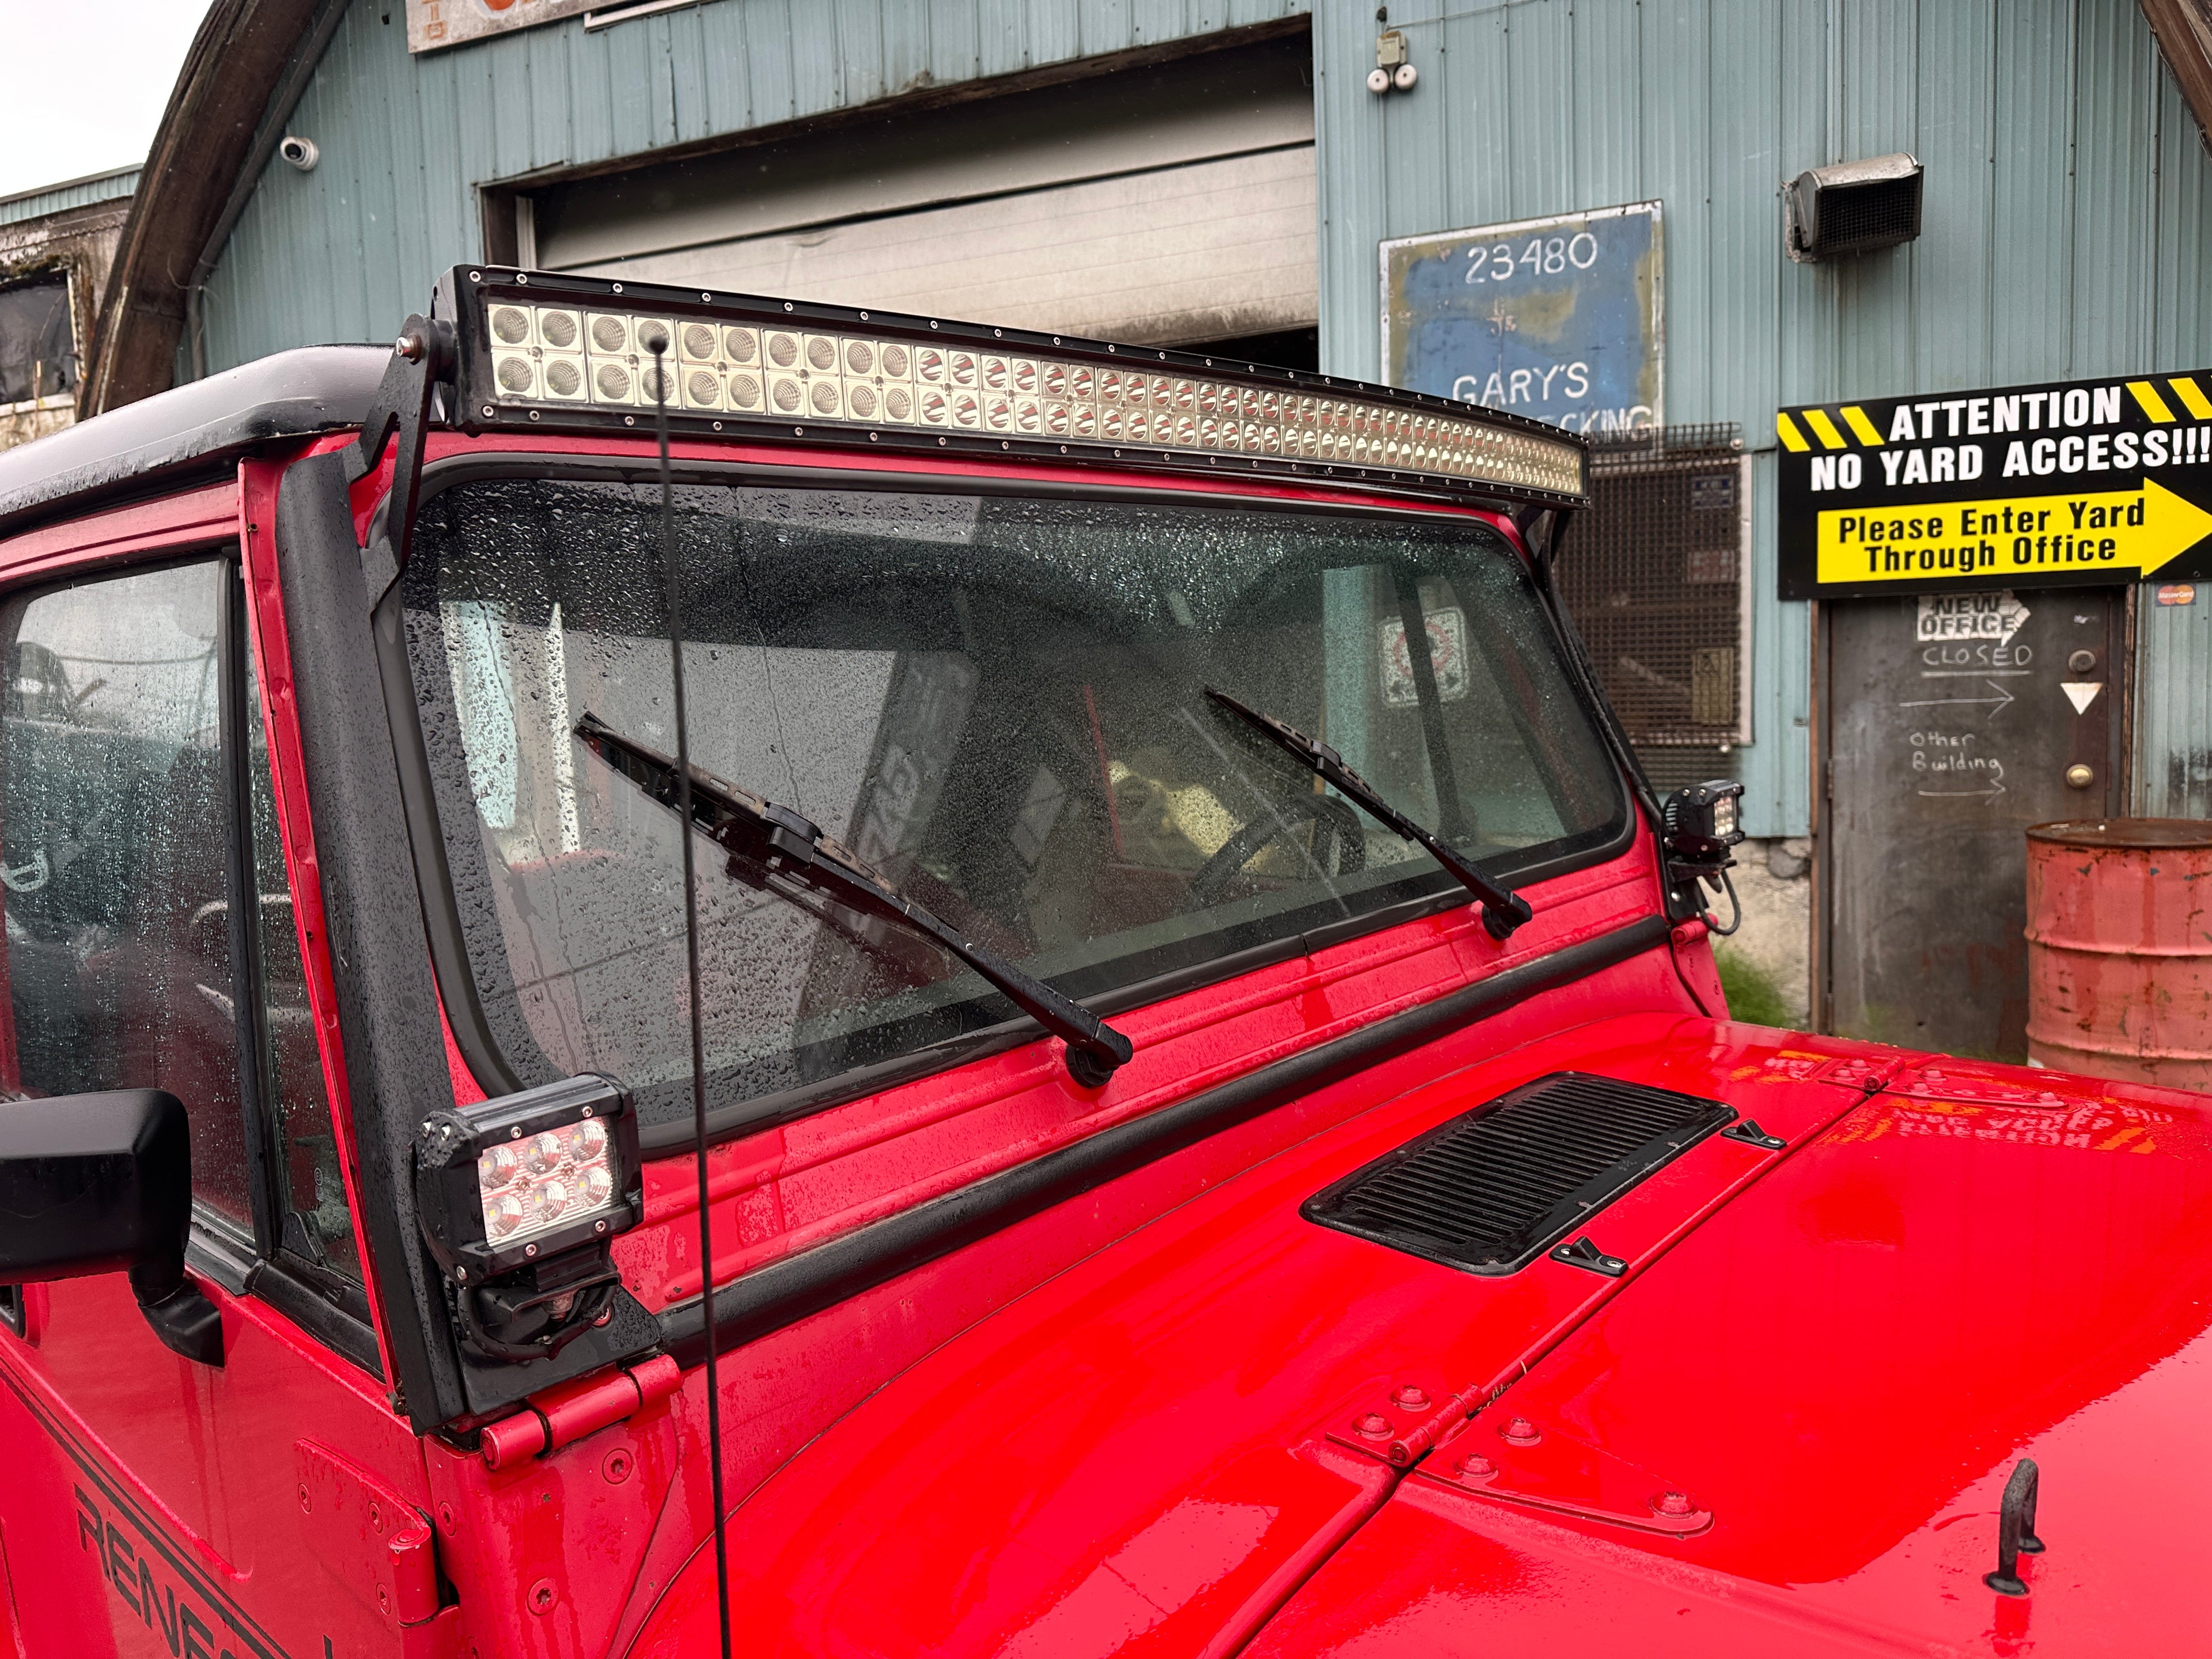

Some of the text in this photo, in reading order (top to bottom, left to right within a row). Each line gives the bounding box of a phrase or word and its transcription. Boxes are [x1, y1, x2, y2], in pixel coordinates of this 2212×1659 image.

[1465, 232, 1598, 284] 23480
[1452, 361, 1589, 407] GARY'S
[1889, 386, 2122, 442] ATTENTION
[1810, 426, 2211, 491] NO YARD ACCESS!!!
[1839, 497, 2145, 543] Please Enter Yard
[1864, 536, 2116, 573] Through Office
[1921, 614, 2017, 634] OFFICE
[1932, 596, 2001, 615] NEW
[1922, 644, 2033, 666] CLOSED
[1912, 750, 2004, 782] Building
[73, 1482, 237, 1659] RENE
